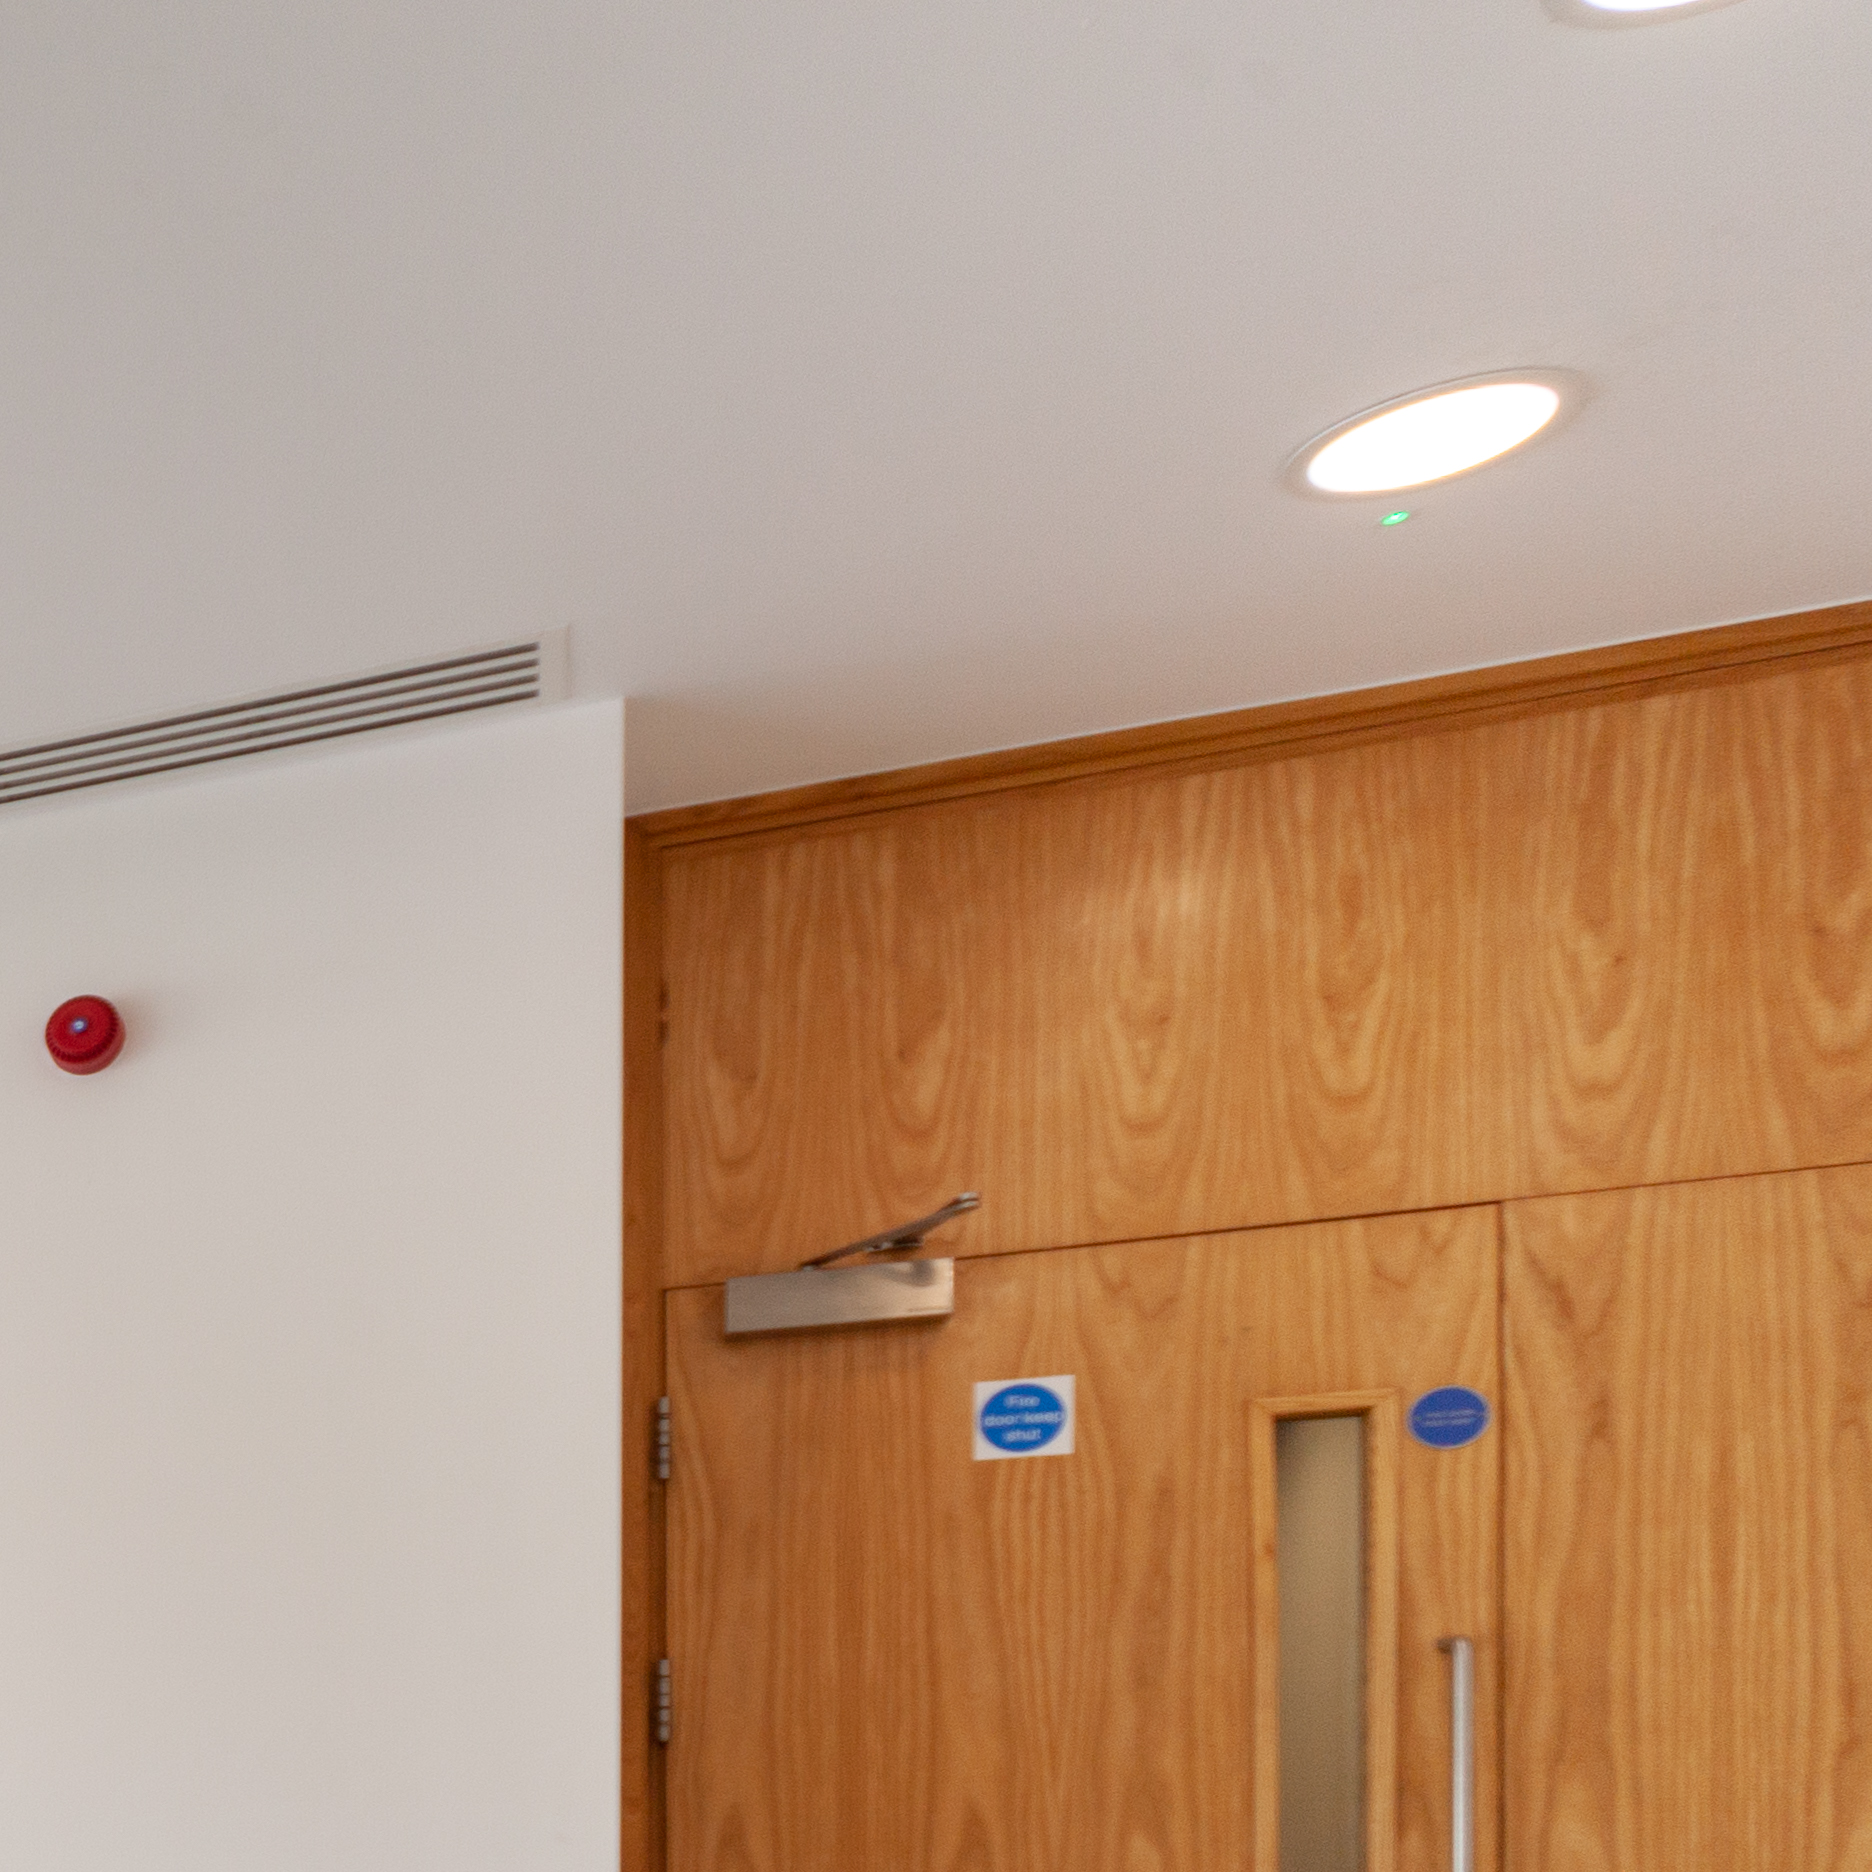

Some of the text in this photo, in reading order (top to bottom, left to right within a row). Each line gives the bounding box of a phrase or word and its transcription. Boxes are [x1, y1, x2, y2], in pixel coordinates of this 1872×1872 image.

[984, 1410, 1063, 1428] door keep
[1004, 1428, 1041, 1442] shut
